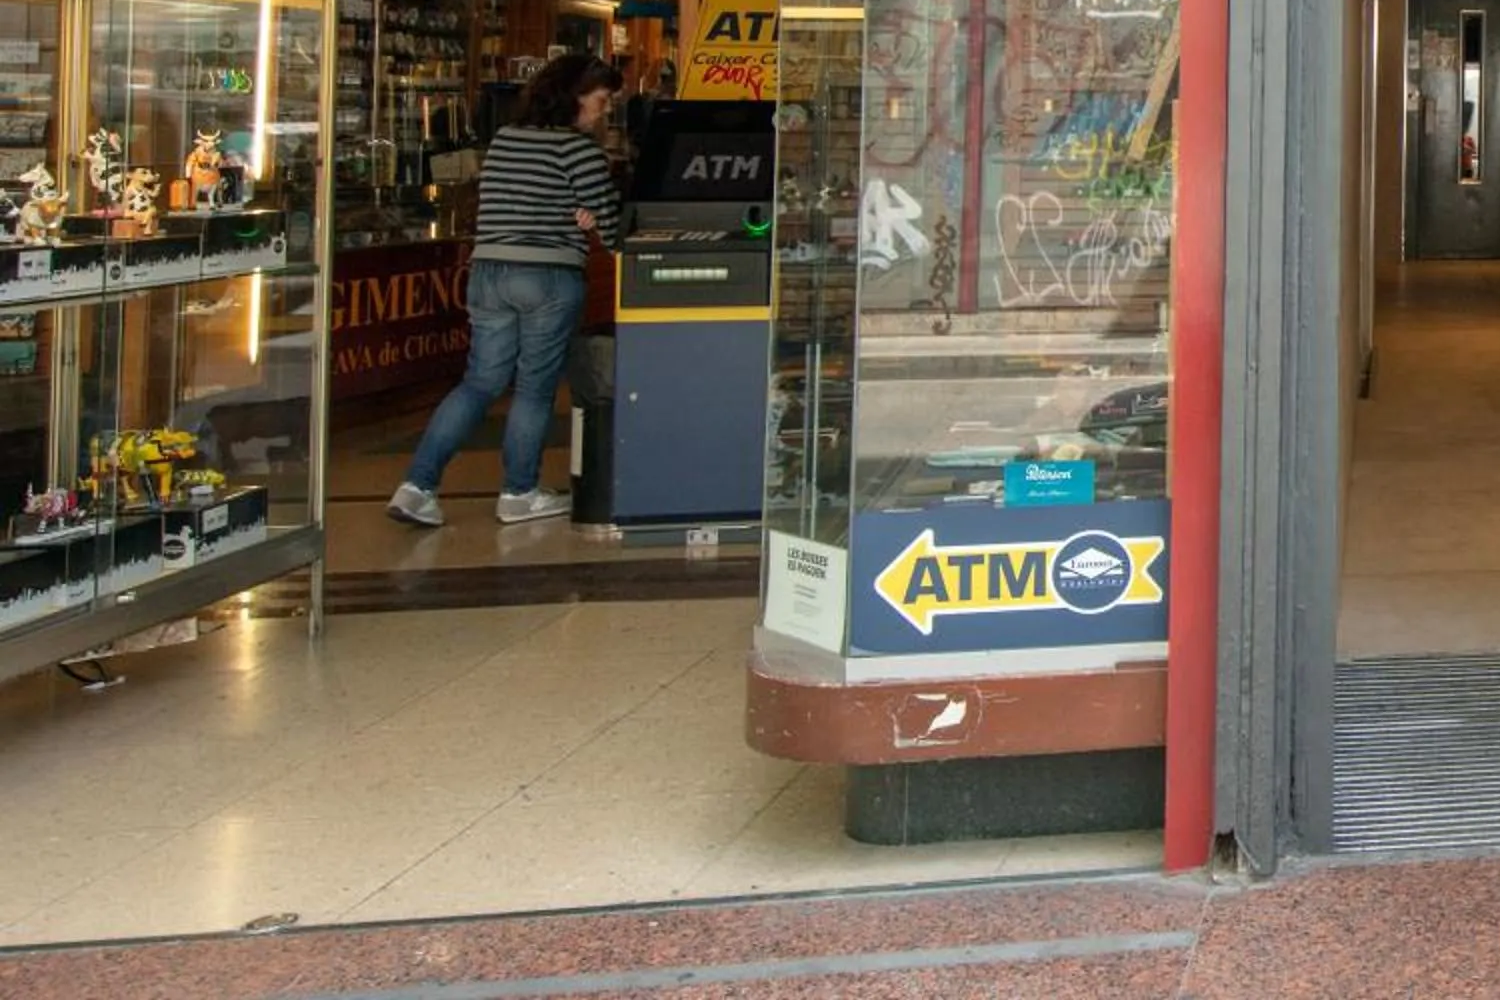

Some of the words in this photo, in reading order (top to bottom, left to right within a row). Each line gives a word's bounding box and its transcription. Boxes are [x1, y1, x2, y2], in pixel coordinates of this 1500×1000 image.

[704, 11, 779, 42] AT
[682, 154, 763, 180] ATM
[333, 345, 373, 375] AVA
[903, 551, 1047, 604] ATM
